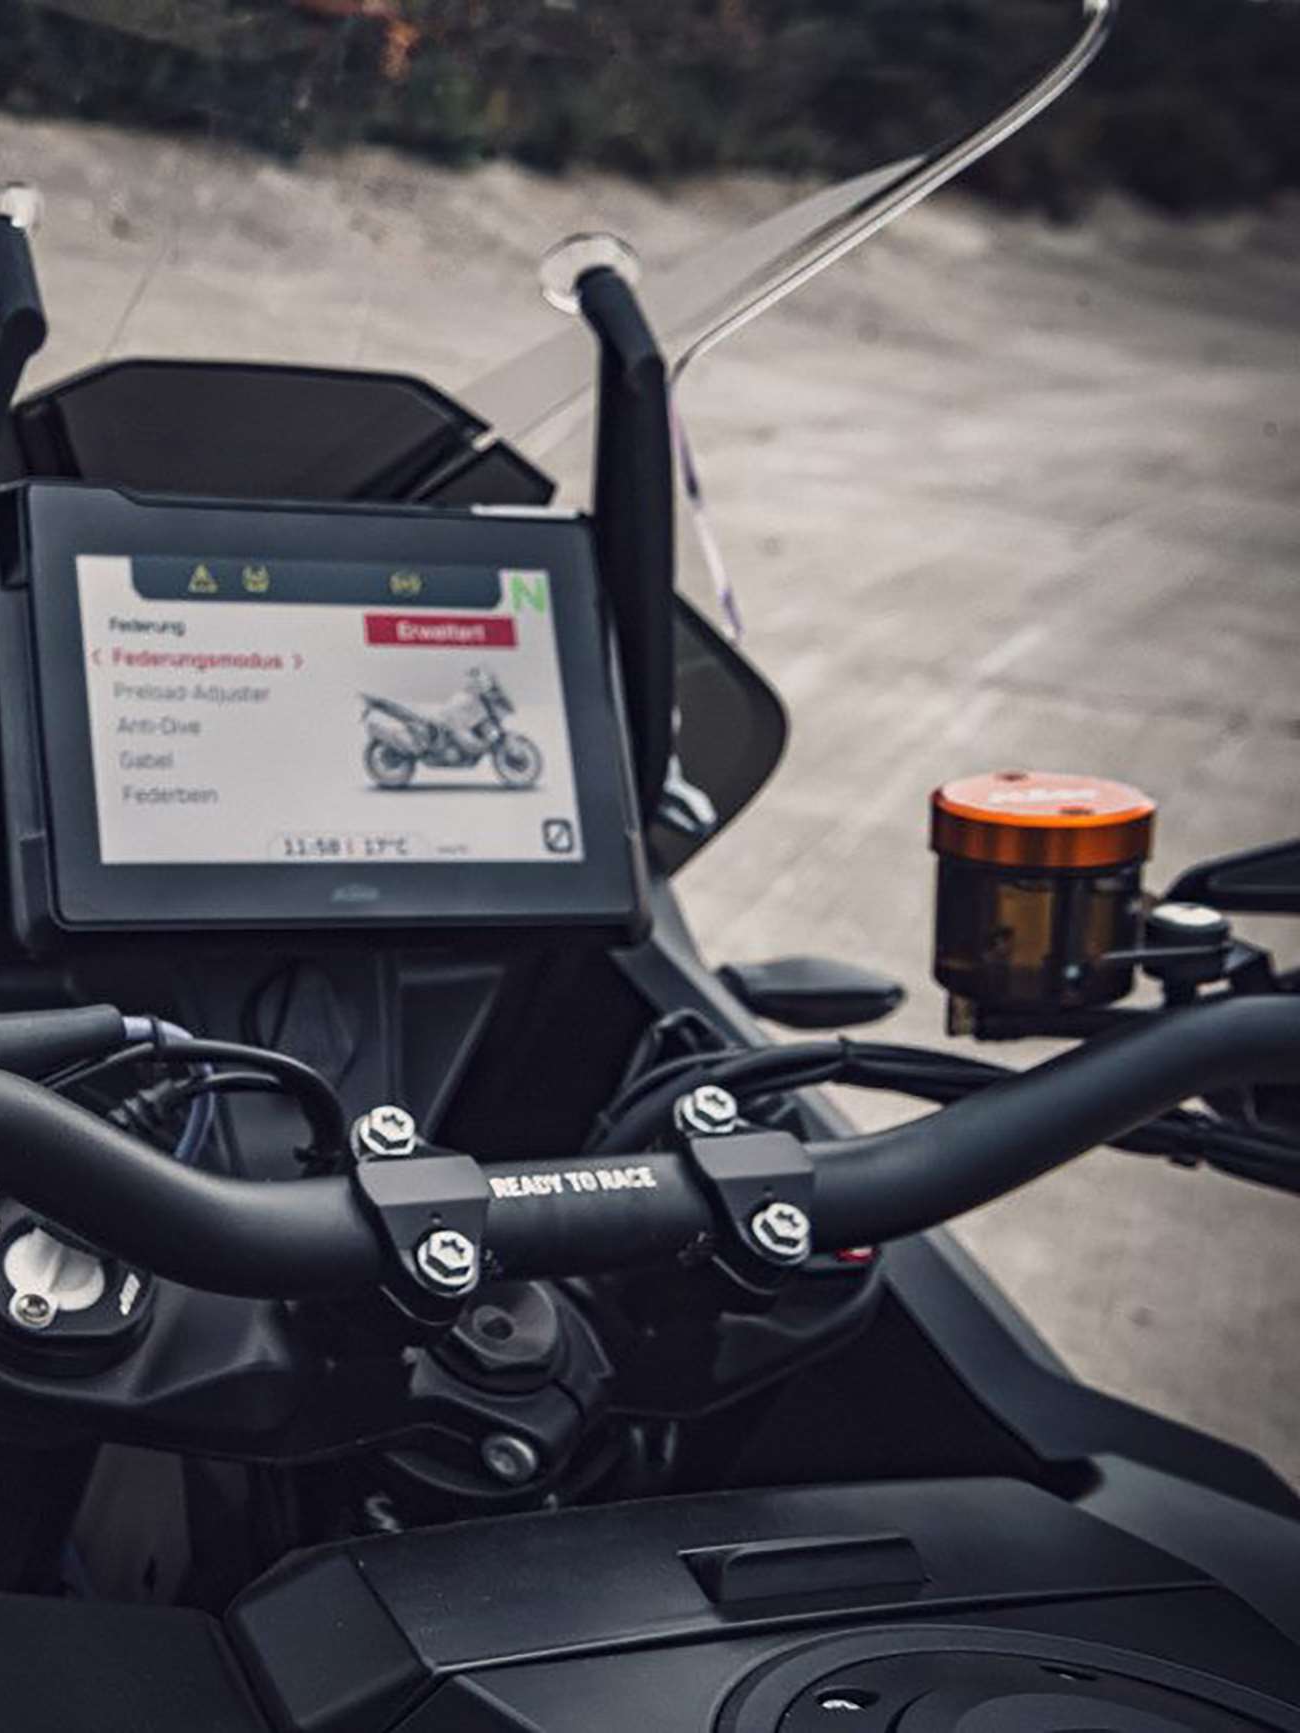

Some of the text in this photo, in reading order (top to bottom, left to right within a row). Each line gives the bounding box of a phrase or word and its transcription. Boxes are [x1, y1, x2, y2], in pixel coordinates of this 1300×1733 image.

[108, 616, 187, 637] Federung
[111, 648, 284, 671] Federungsmodus
[120, 751, 174, 770] Gabel
[122, 785, 220, 805] Federbein
[489, 1167, 657, 1198] READY TO RACE
